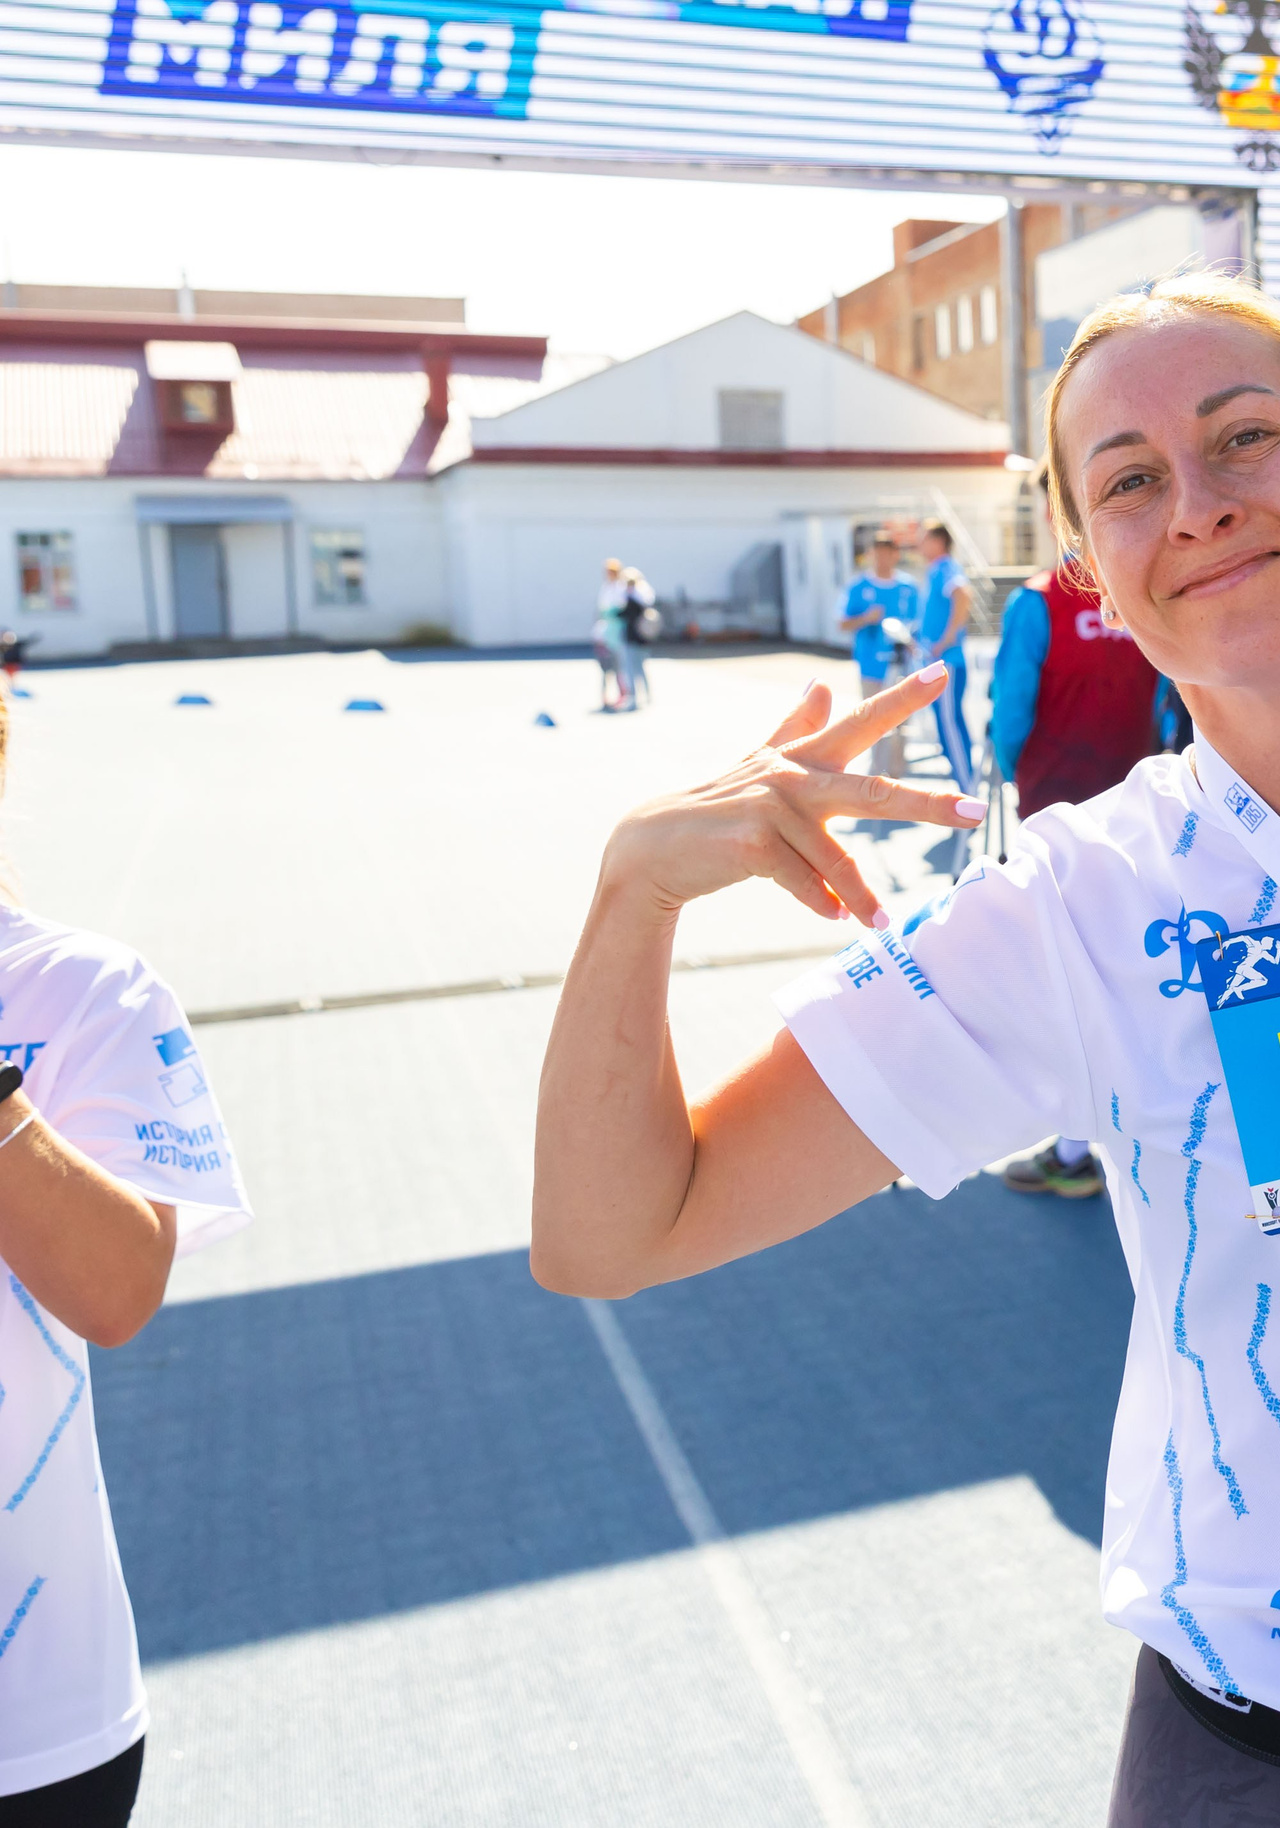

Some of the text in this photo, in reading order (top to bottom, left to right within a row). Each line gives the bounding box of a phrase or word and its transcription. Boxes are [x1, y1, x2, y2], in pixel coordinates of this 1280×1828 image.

[125, 0, 516, 99] МИЛЯ
[1243, 804, 1262, 828] 185
[135, 1121, 214, 1147] ИСТОРИЯ
[143, 1144, 222, 1173] ИСТОРИЯ
